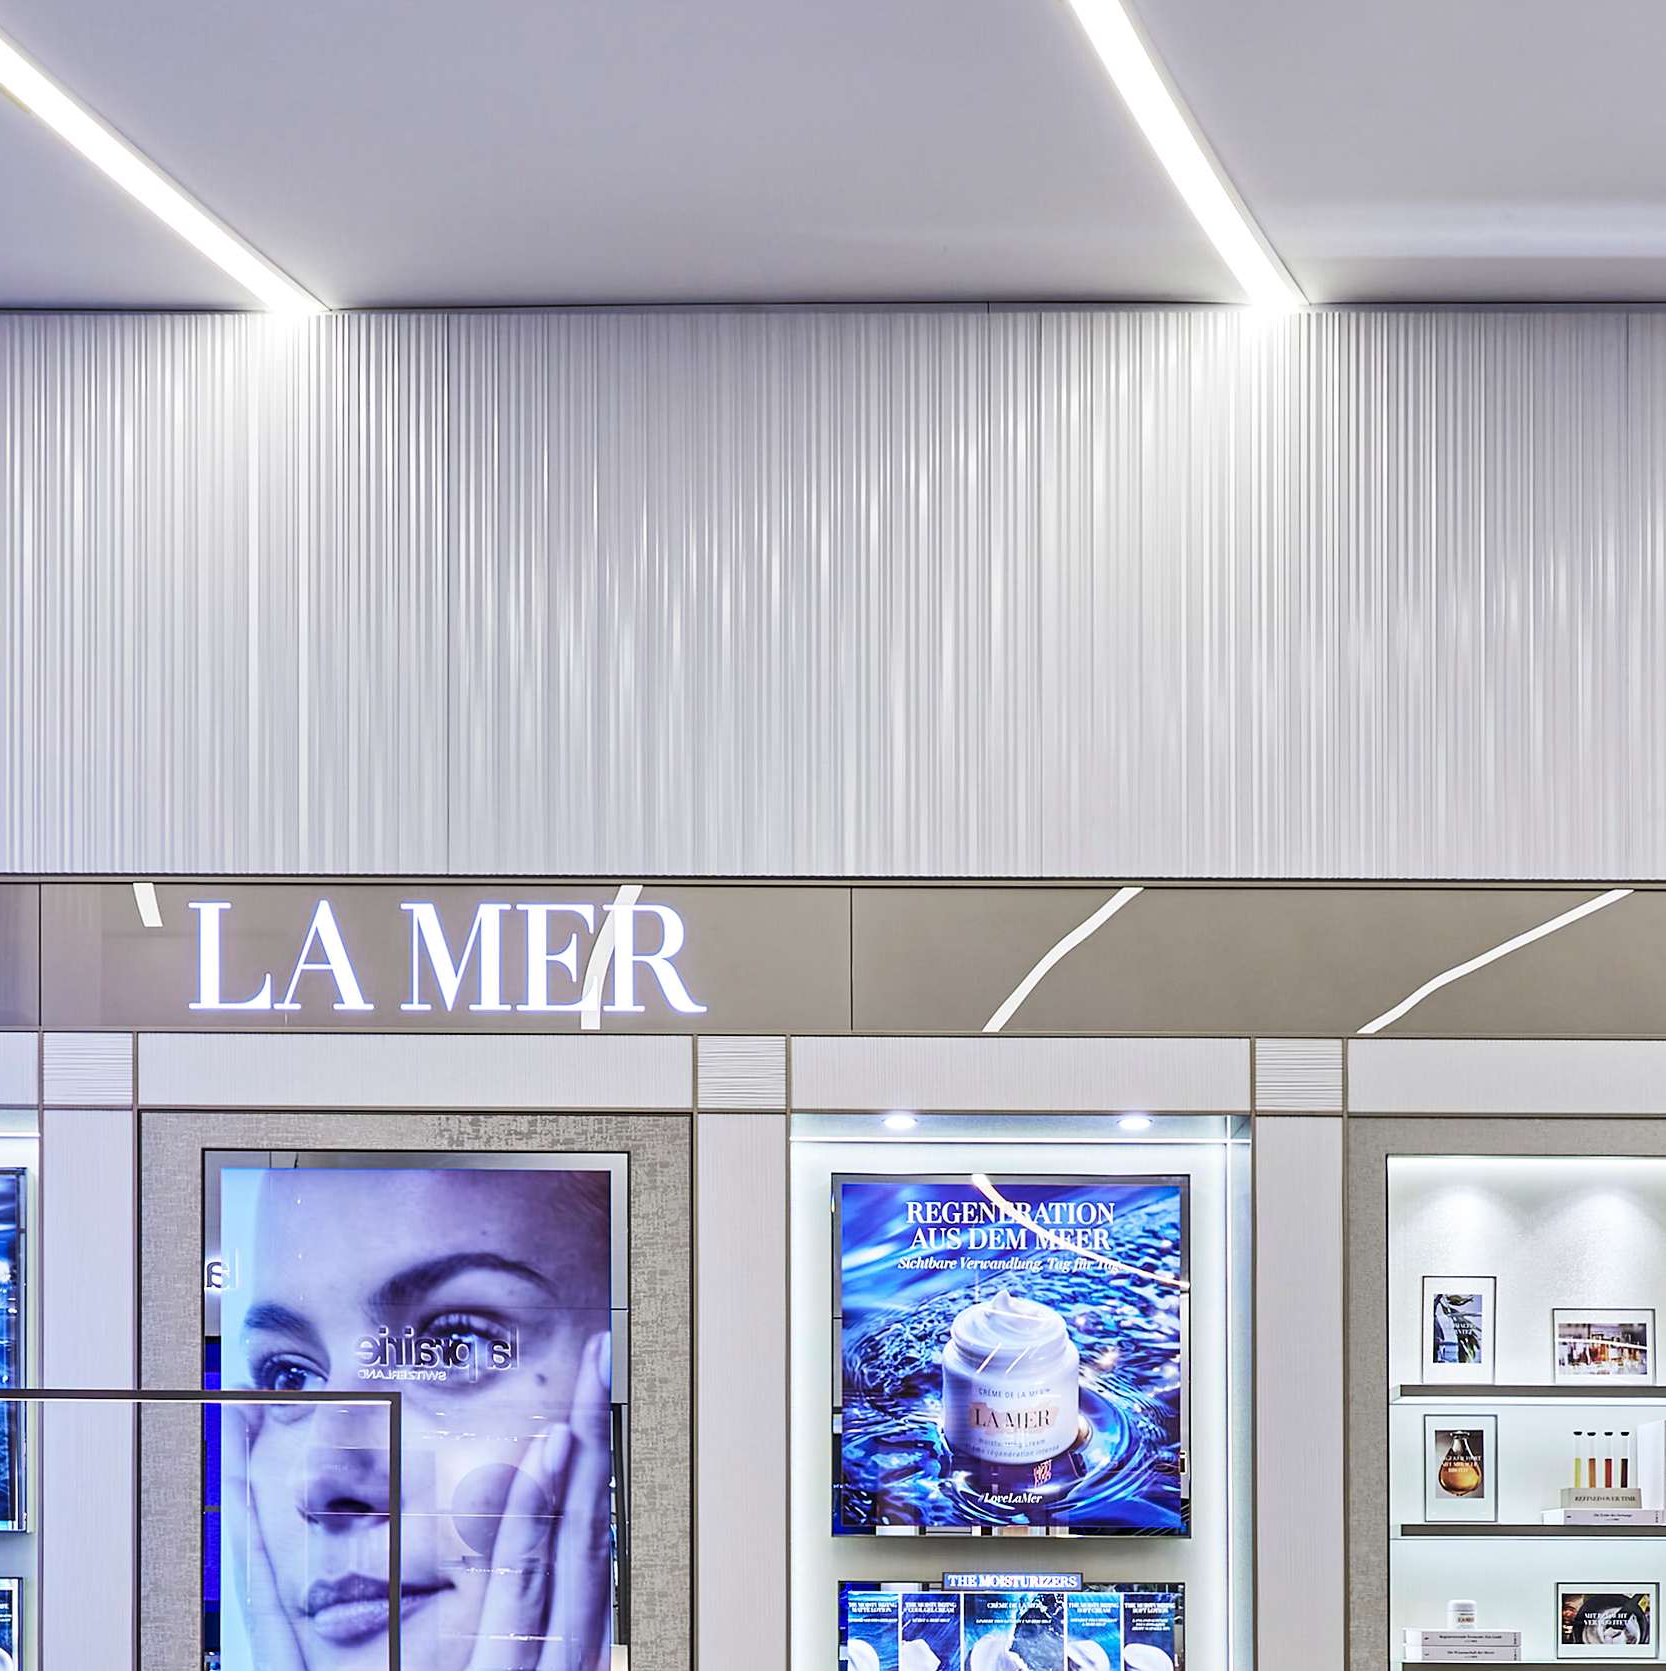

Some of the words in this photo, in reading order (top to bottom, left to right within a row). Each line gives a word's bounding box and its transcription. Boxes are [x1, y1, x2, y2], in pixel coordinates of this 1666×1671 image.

[188, 899, 375, 1011] LA
[399, 901, 708, 1014] MER
[905, 1201, 1115, 1225] REGENERATION
[909, 1227, 963, 1251] AUS
[967, 1227, 1028, 1251] DEM
[1034, 1228, 1112, 1251] MEER
[897, 1255, 957, 1270] Sichtbare
[1046, 1256, 1071, 1273] Tag
[1071, 1256, 1093, 1273] für
[974, 1408, 999, 1429] LA
[1005, 1409, 1050, 1430] MER
[977, 1492, 1043, 1505] #LoveLaMer
[947, 1574, 978, 1587] THE
[979, 1574, 1078, 1588] MOISTURIZERS
